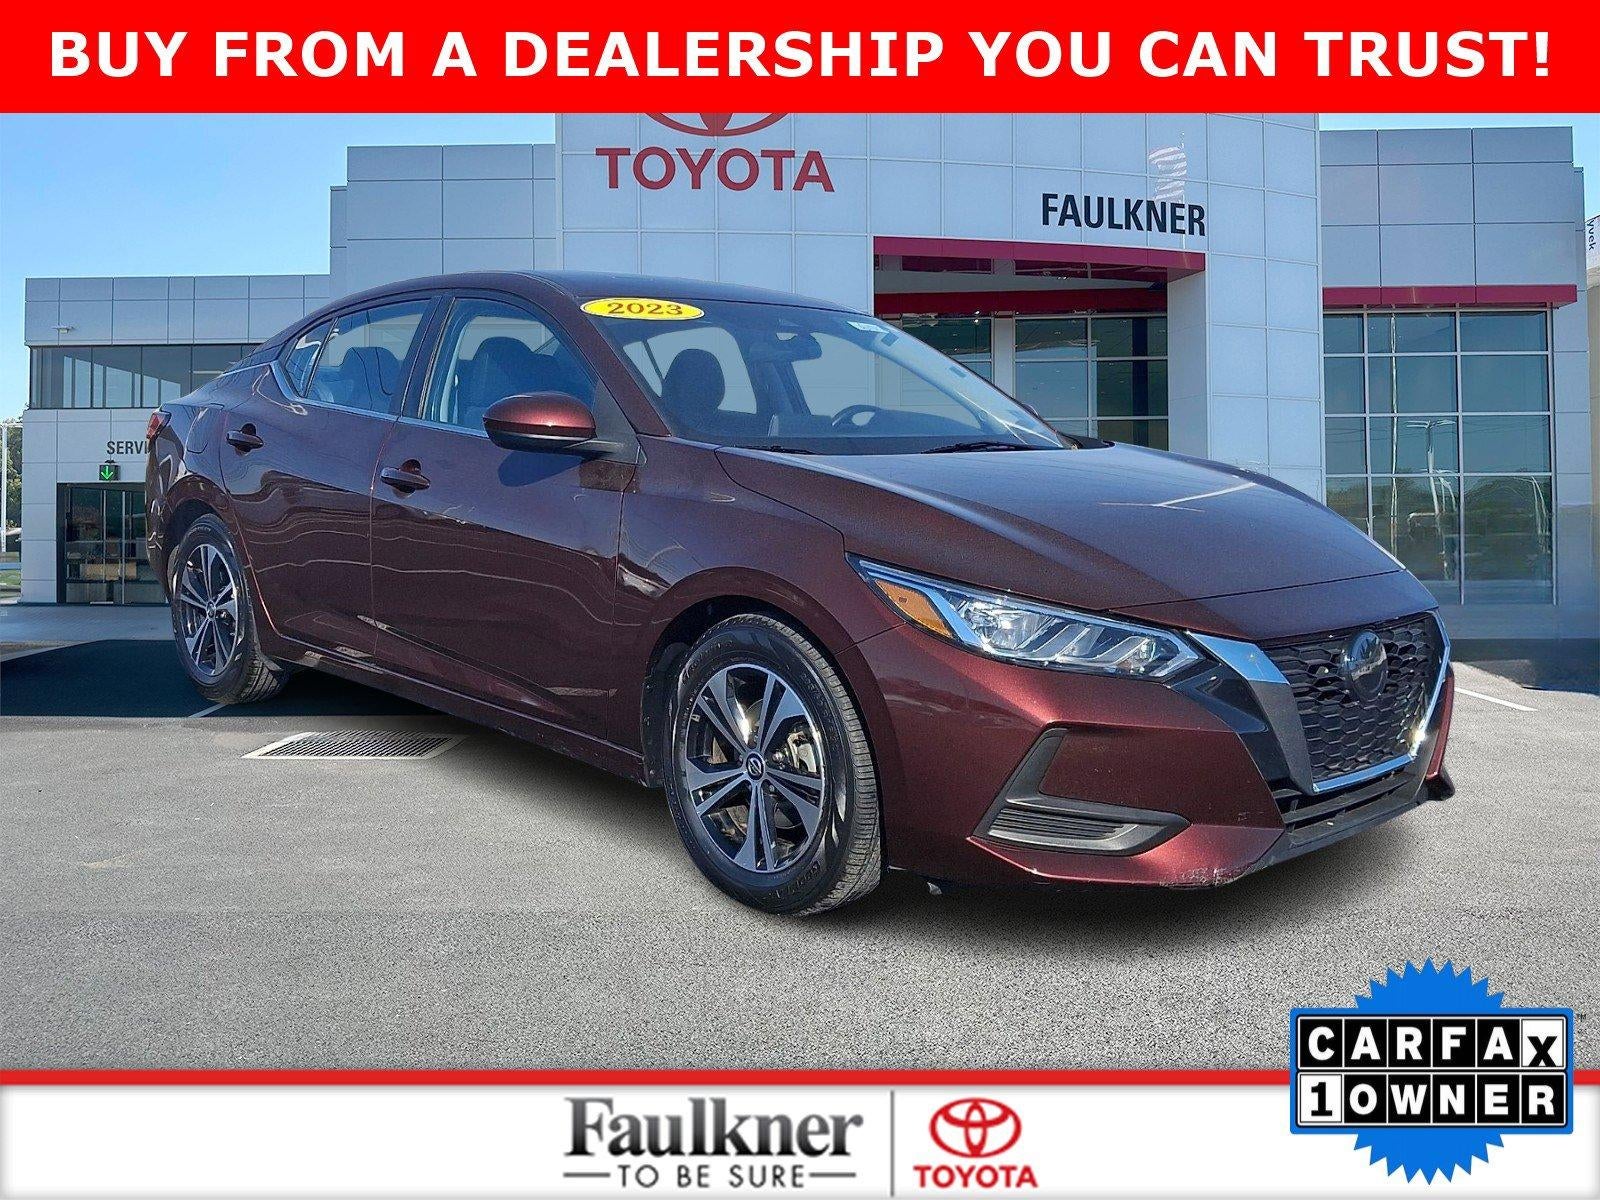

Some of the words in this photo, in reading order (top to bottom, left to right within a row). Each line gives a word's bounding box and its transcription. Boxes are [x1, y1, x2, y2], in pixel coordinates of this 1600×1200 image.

[595, 146, 835, 193] TOYOTA
[1041, 192, 1206, 237] FAULKNER
[607, 302, 684, 316] 2023
